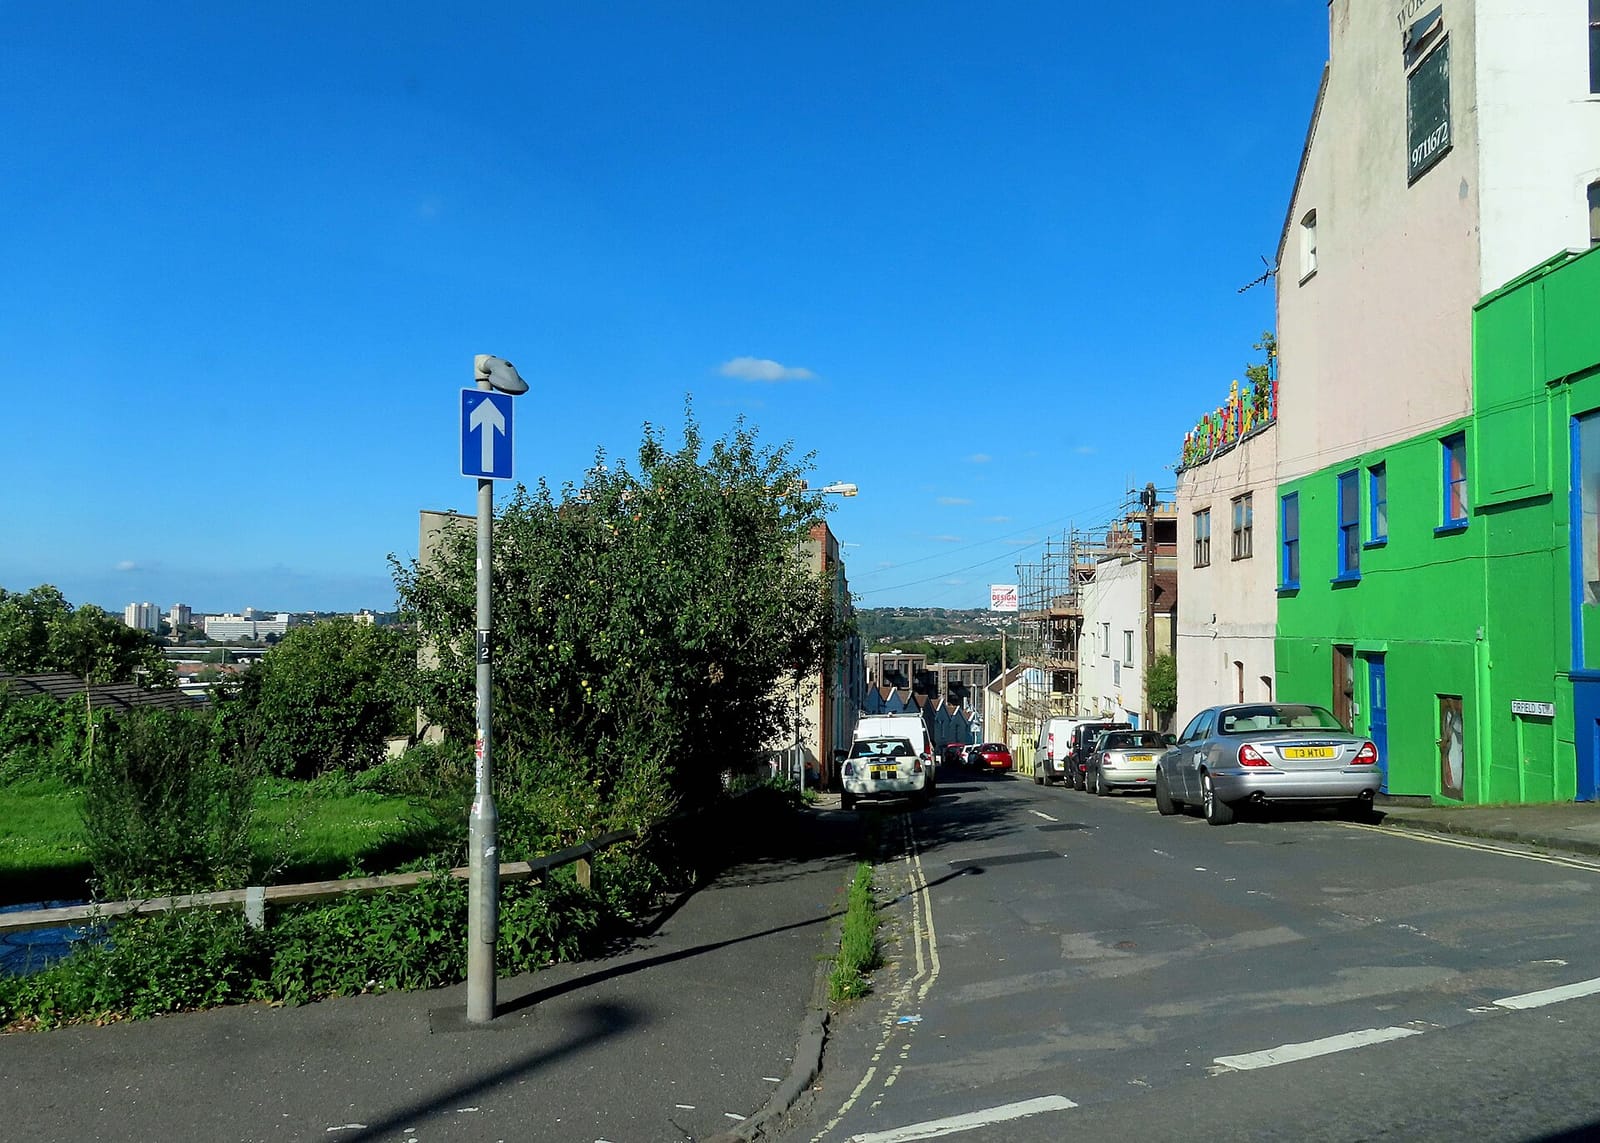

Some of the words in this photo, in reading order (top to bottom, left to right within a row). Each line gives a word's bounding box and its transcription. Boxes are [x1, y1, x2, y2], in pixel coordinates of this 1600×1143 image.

[1412, 121, 1448, 167] 9711672
[480, 630, 490, 642] T
[481, 647, 489, 658] 2
[1513, 702, 1536, 713] FIRFIELD
